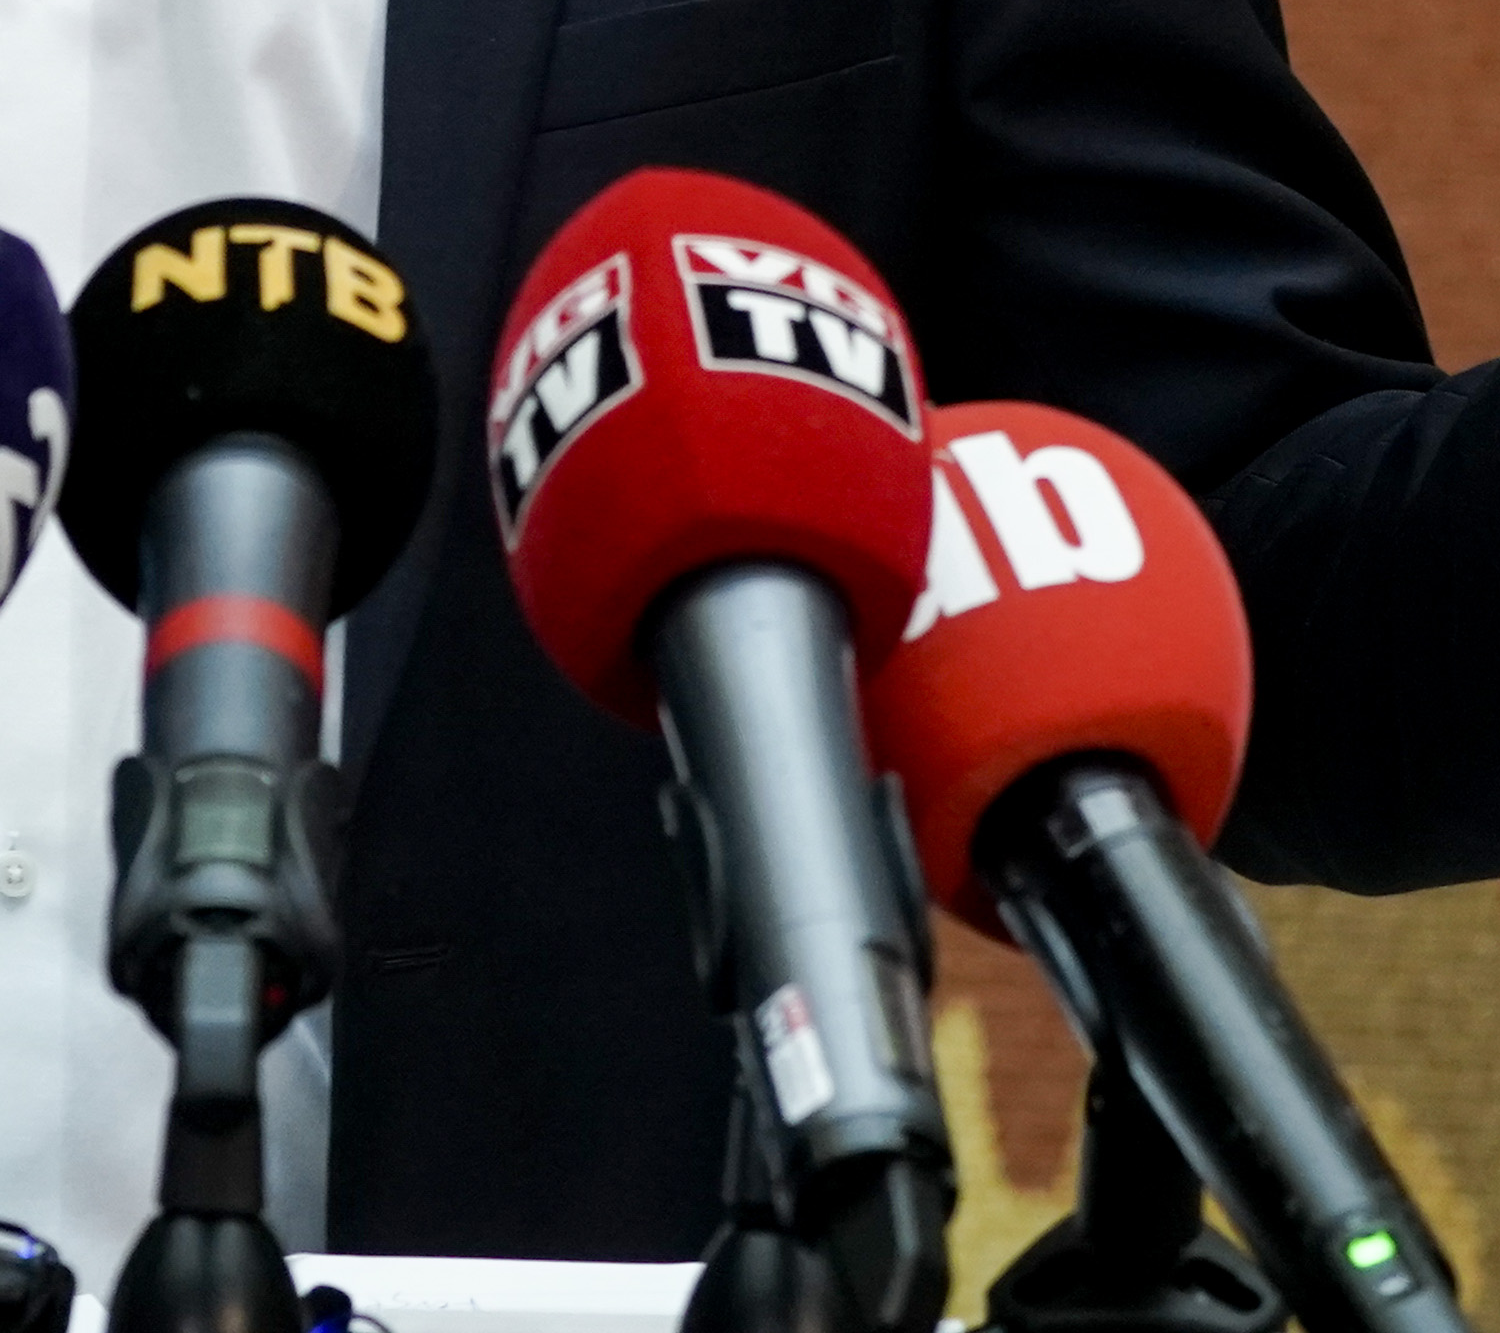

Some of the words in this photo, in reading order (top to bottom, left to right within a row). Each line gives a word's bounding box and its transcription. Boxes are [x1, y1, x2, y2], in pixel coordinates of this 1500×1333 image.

[131, 222, 408, 344] NTB
[690, 241, 888, 338] VG
[726, 289, 886, 398] TV
[502, 330, 600, 490] TV
